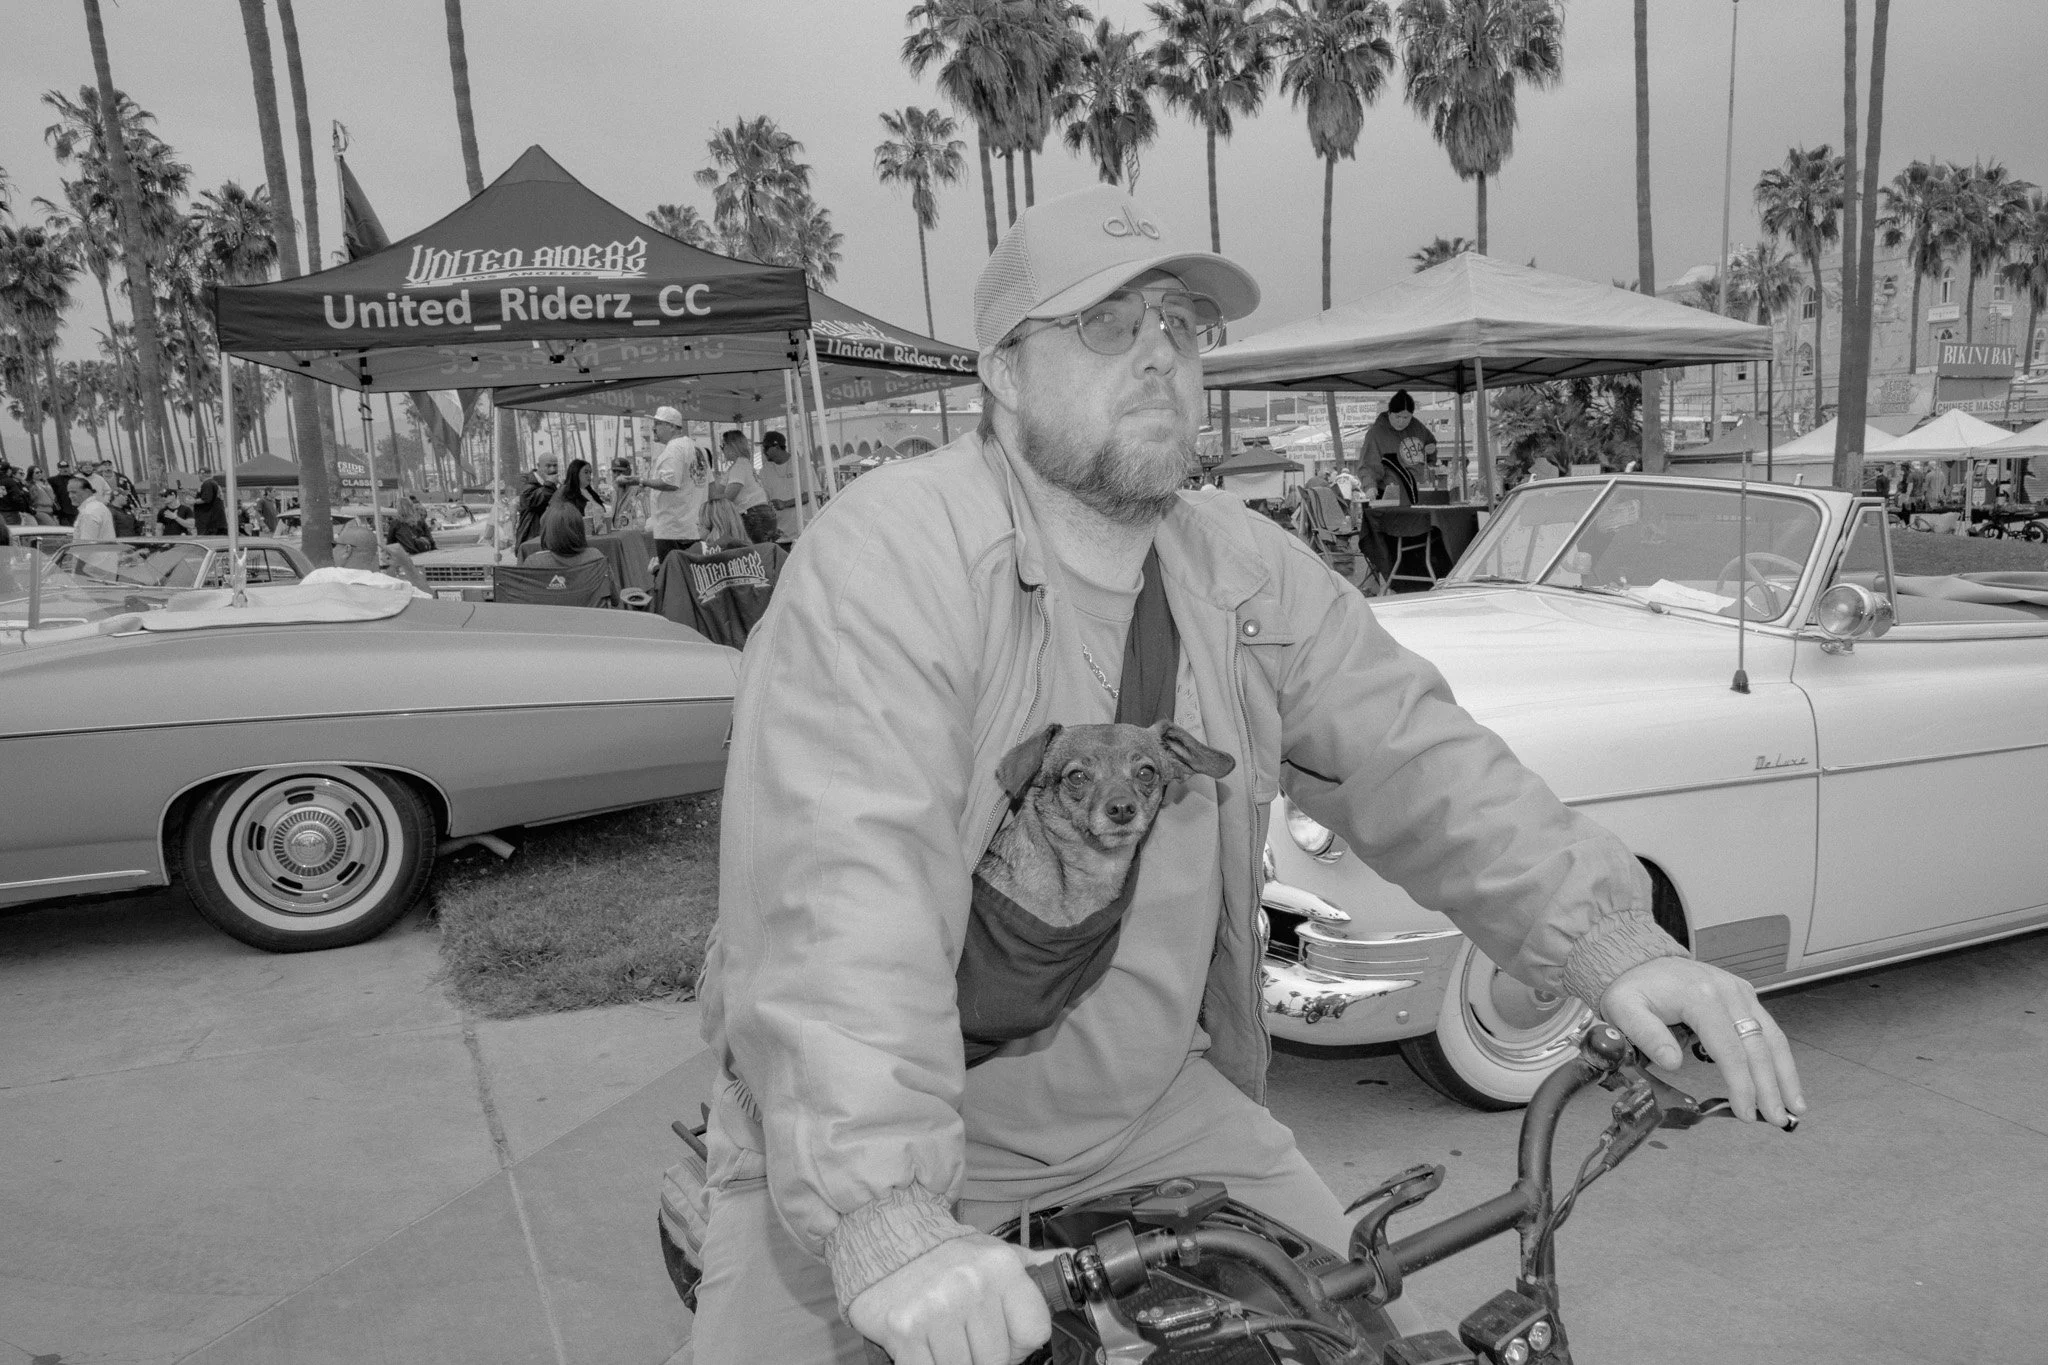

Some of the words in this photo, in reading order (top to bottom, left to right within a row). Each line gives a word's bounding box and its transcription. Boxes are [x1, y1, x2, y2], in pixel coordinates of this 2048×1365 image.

[405, 244, 524, 283] UNITED
[1943, 345, 1990, 365] BIKINI
[1991, 346, 2015, 365] BAY
